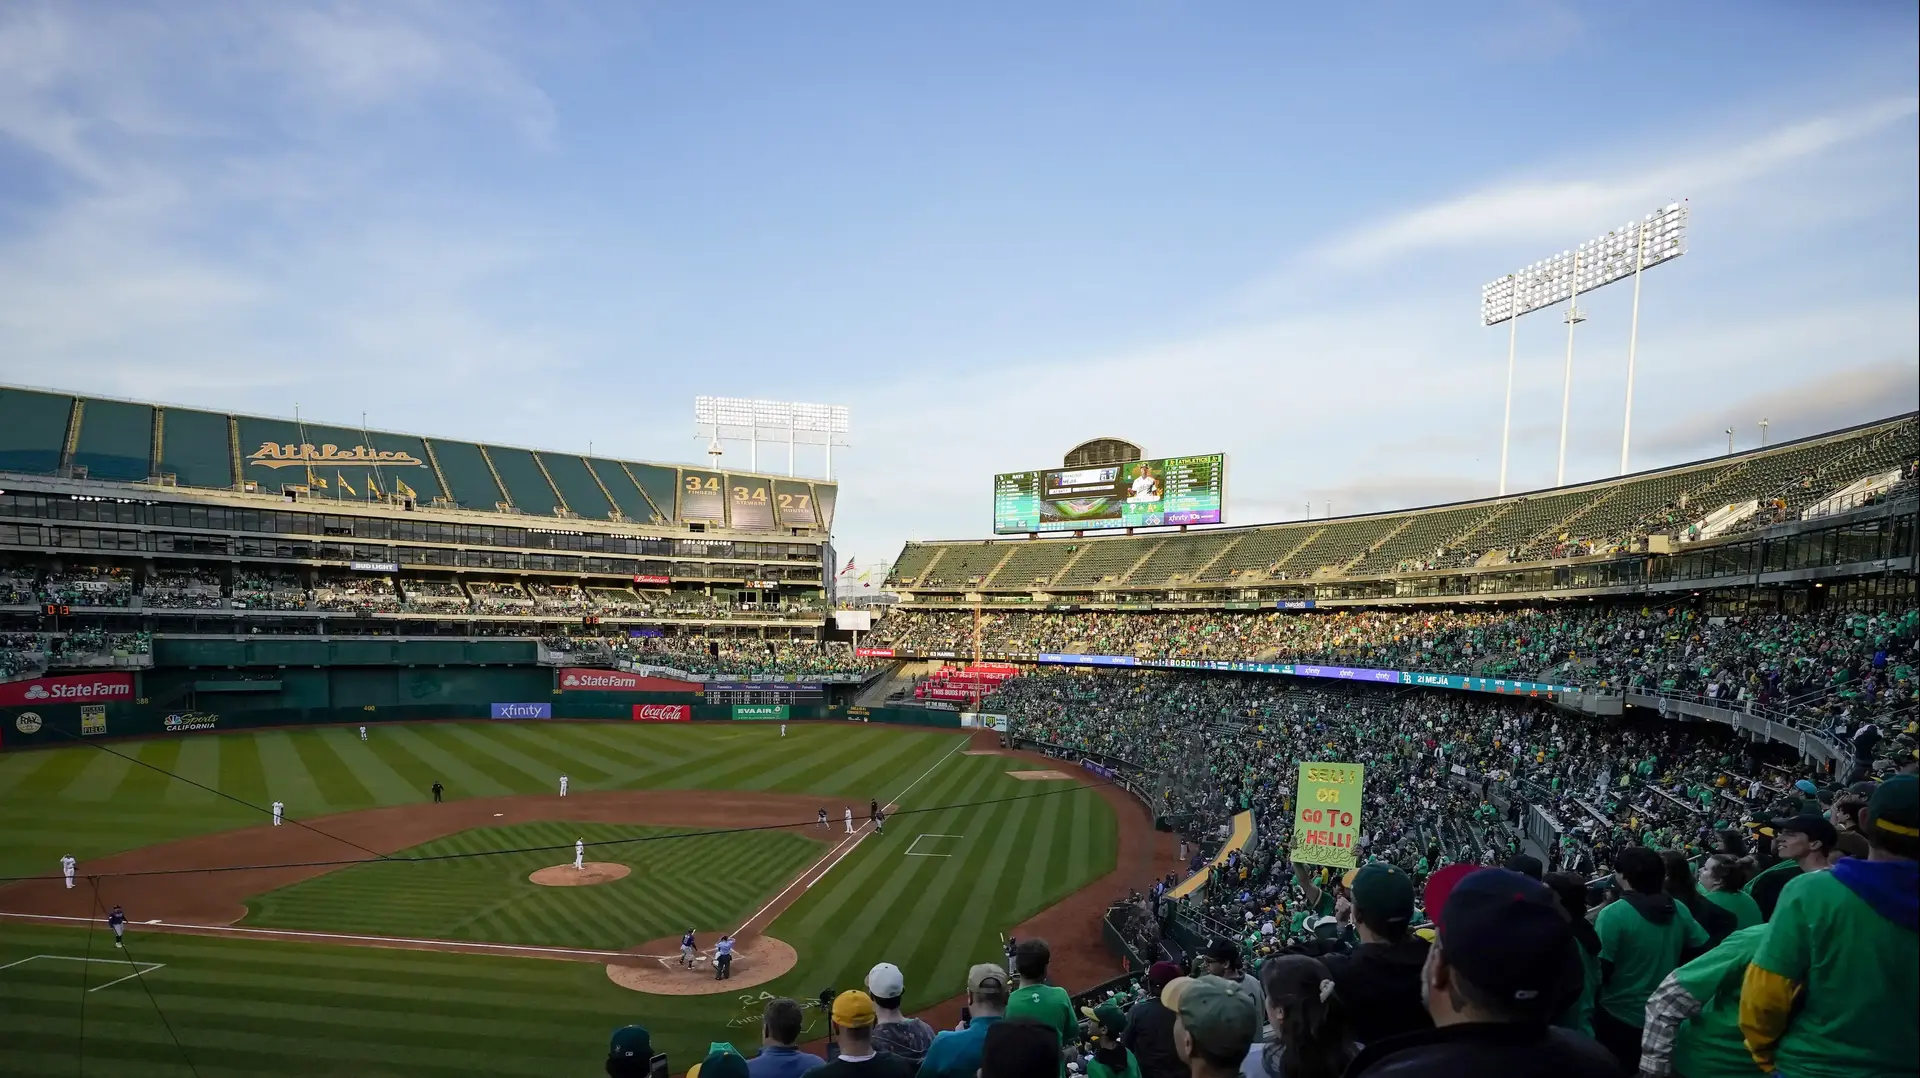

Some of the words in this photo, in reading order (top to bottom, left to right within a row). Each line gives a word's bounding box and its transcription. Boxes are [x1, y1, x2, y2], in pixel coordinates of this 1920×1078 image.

[247, 441, 415, 463] Athletics
[686, 476, 720, 491] 34
[734, 487, 768, 501] 34
[778, 494, 810, 508] 27
[636, 576, 668, 584] Budweiser
[1305, 667, 1320, 676] xfinity
[1339, 669, 1354, 678] xfinity
[1375, 671, 1390, 680] xfinity
[501, 704, 542, 718] xfinity
[640, 705, 682, 720] Coca-Cola
[181, 713, 219, 724] Sports
[166, 723, 215, 731] CALIFORNIA
[1316, 788, 1340, 803] OR
[1302, 808, 1322, 824] GO
[1327, 809, 1353, 828] TO
[1306, 830, 1351, 848] HELL!
[738, 991, 776, 1006] 24
